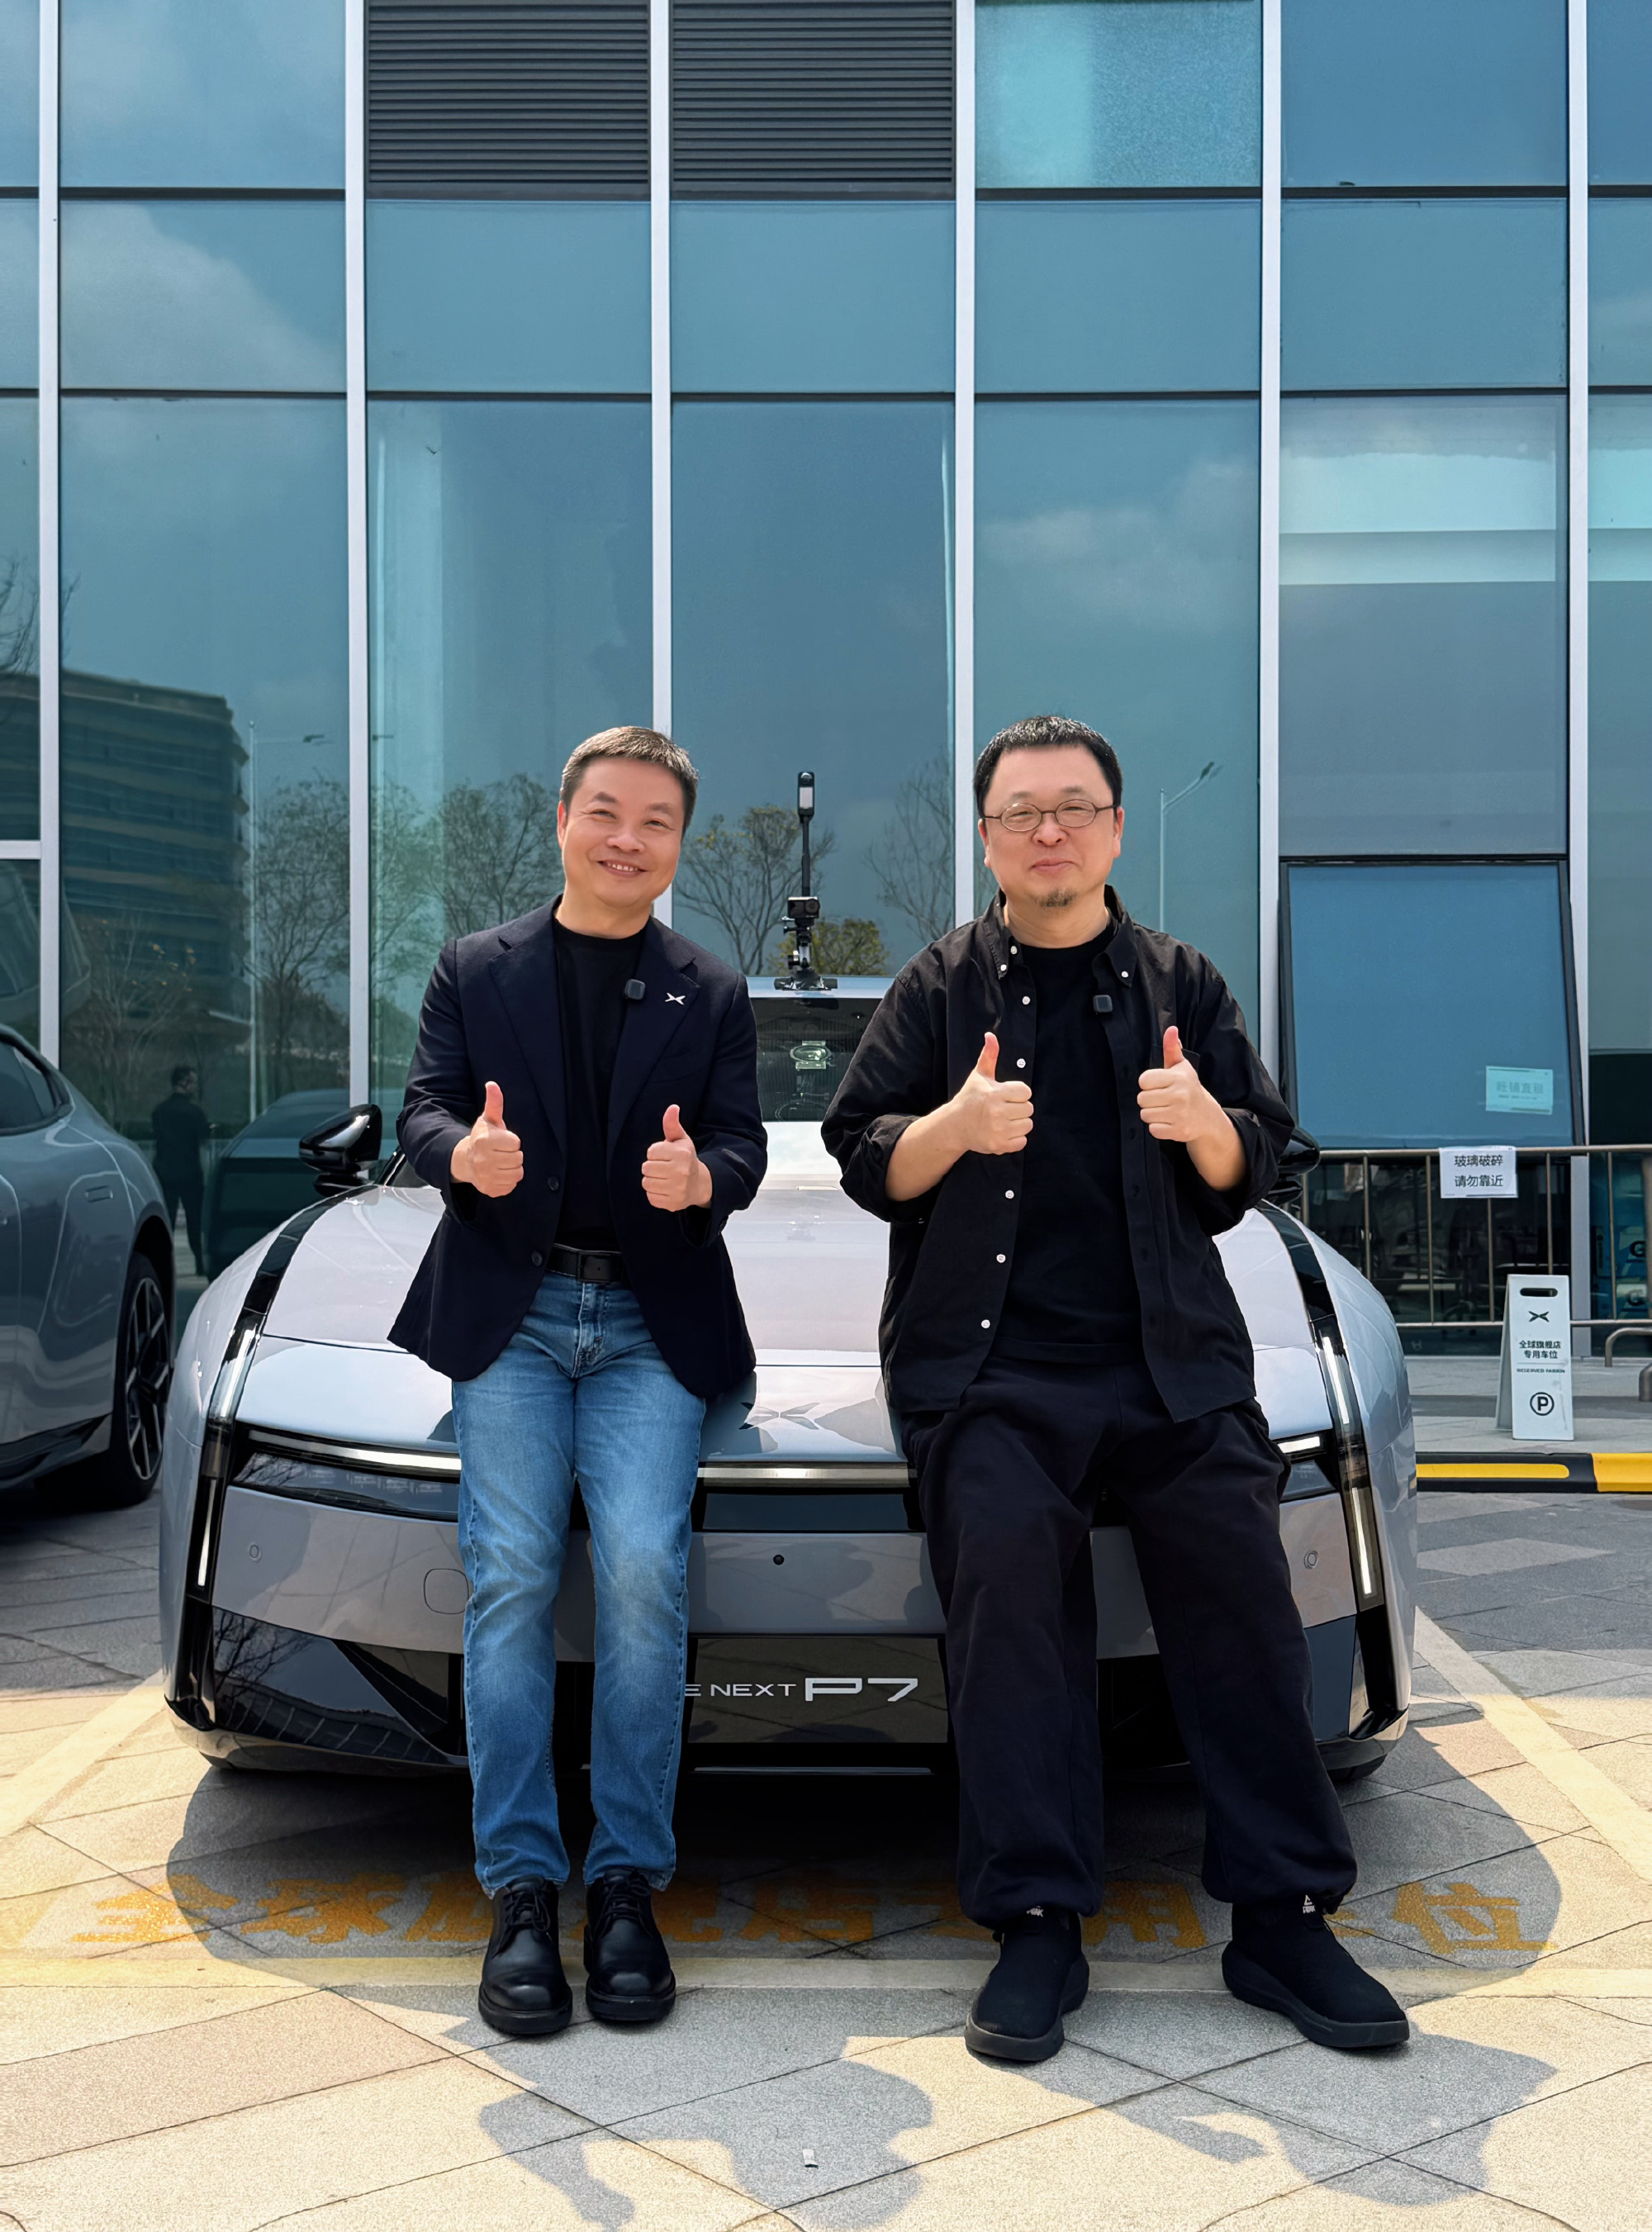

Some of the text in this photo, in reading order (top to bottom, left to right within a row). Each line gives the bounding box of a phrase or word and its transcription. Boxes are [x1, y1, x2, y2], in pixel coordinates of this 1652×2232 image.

[1454, 1154, 1503, 1167] 玻璃破碎
[1454, 1174, 1503, 1188] 请勿靠近
[1519, 1340, 1561, 1349] 全球旗舰店
[1524, 1350, 1558, 1359] 专用车位
[1537, 1396, 1549, 1411] P
[710, 1683, 797, 1697] NEXT
[805, 1678, 919, 1702] P7
